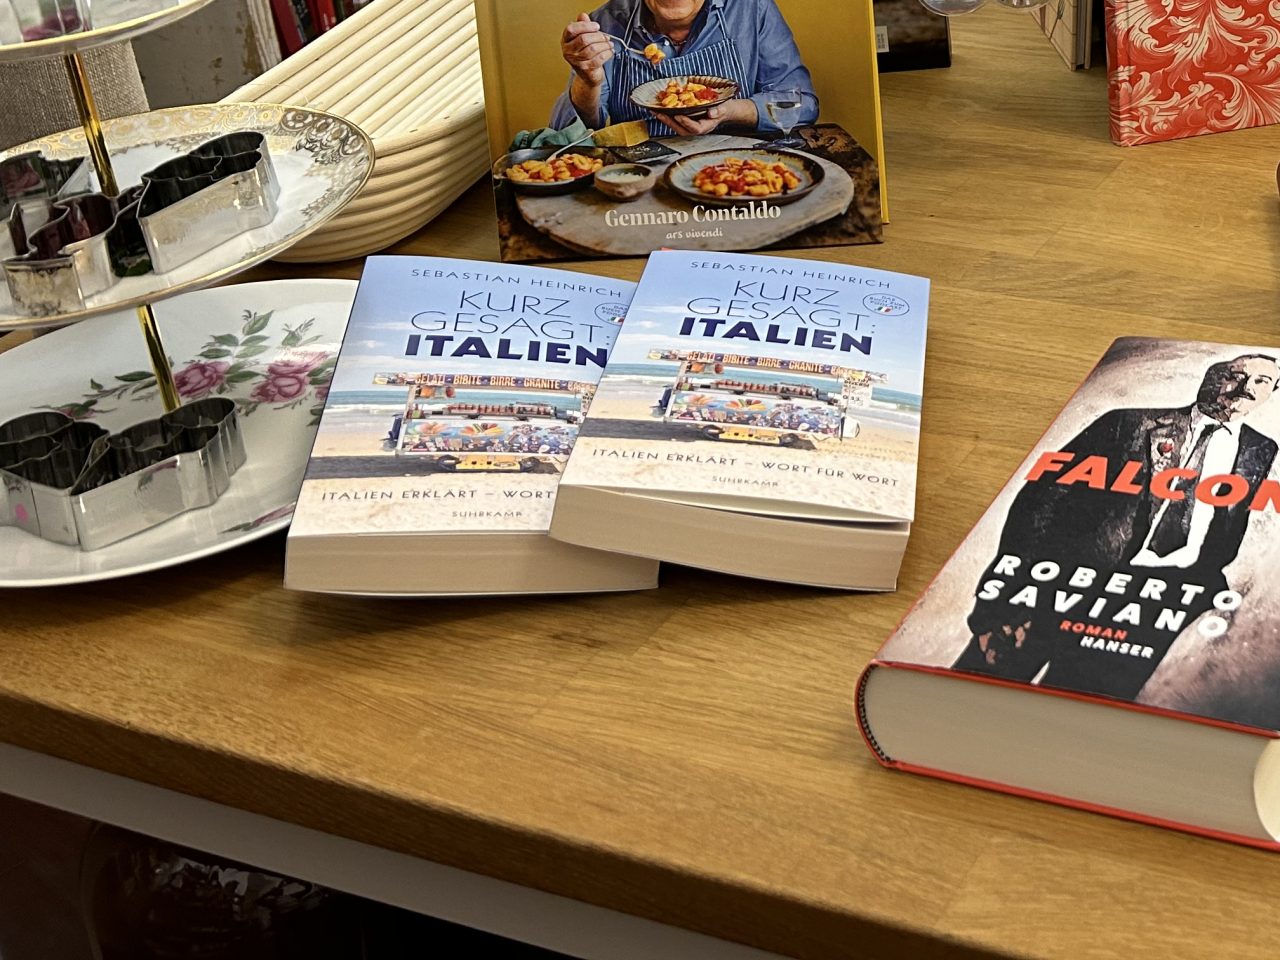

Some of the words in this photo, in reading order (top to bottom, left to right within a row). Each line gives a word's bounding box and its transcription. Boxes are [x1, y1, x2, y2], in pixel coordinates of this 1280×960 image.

[604, 209, 689, 228] Gennaro
[692, 201, 781, 223] Contaldo
[665, 231, 684, 240] ars
[685, 227, 724, 239] vivendi
[411, 268, 521, 284] SEBASTIAN
[530, 279, 622, 298] HEINRICH
[690, 261, 795, 276] SEBASTIAN
[803, 270, 892, 289] HEINRICH
[459, 290, 572, 319] KURZ
[733, 280, 841, 307] KURZ
[411, 310, 613, 346] GESAGT:
[686, 297, 877, 334] GESAGT:
[678, 316, 874, 356] ITALIEN
[404, 334, 609, 369] ITALIEN
[687, 351, 716, 363] GELATI
[722, 353, 750, 366] BIBITE
[757, 355, 782, 369] BIRRE
[788, 360, 825, 373] GRANITE
[592, 448, 659, 461] ITALIEN
[666, 452, 739, 467] ERKLÄRT
[761, 461, 809, 475] WORT
[817, 466, 845, 479] FÜR
[851, 472, 899, 488] WORT
[993, 554, 1243, 612] ROBERTO
[978, 579, 1229, 638] SAVIANO
[1059, 619, 1128, 641] ROMAN
[1081, 635, 1155, 660] HANSER
